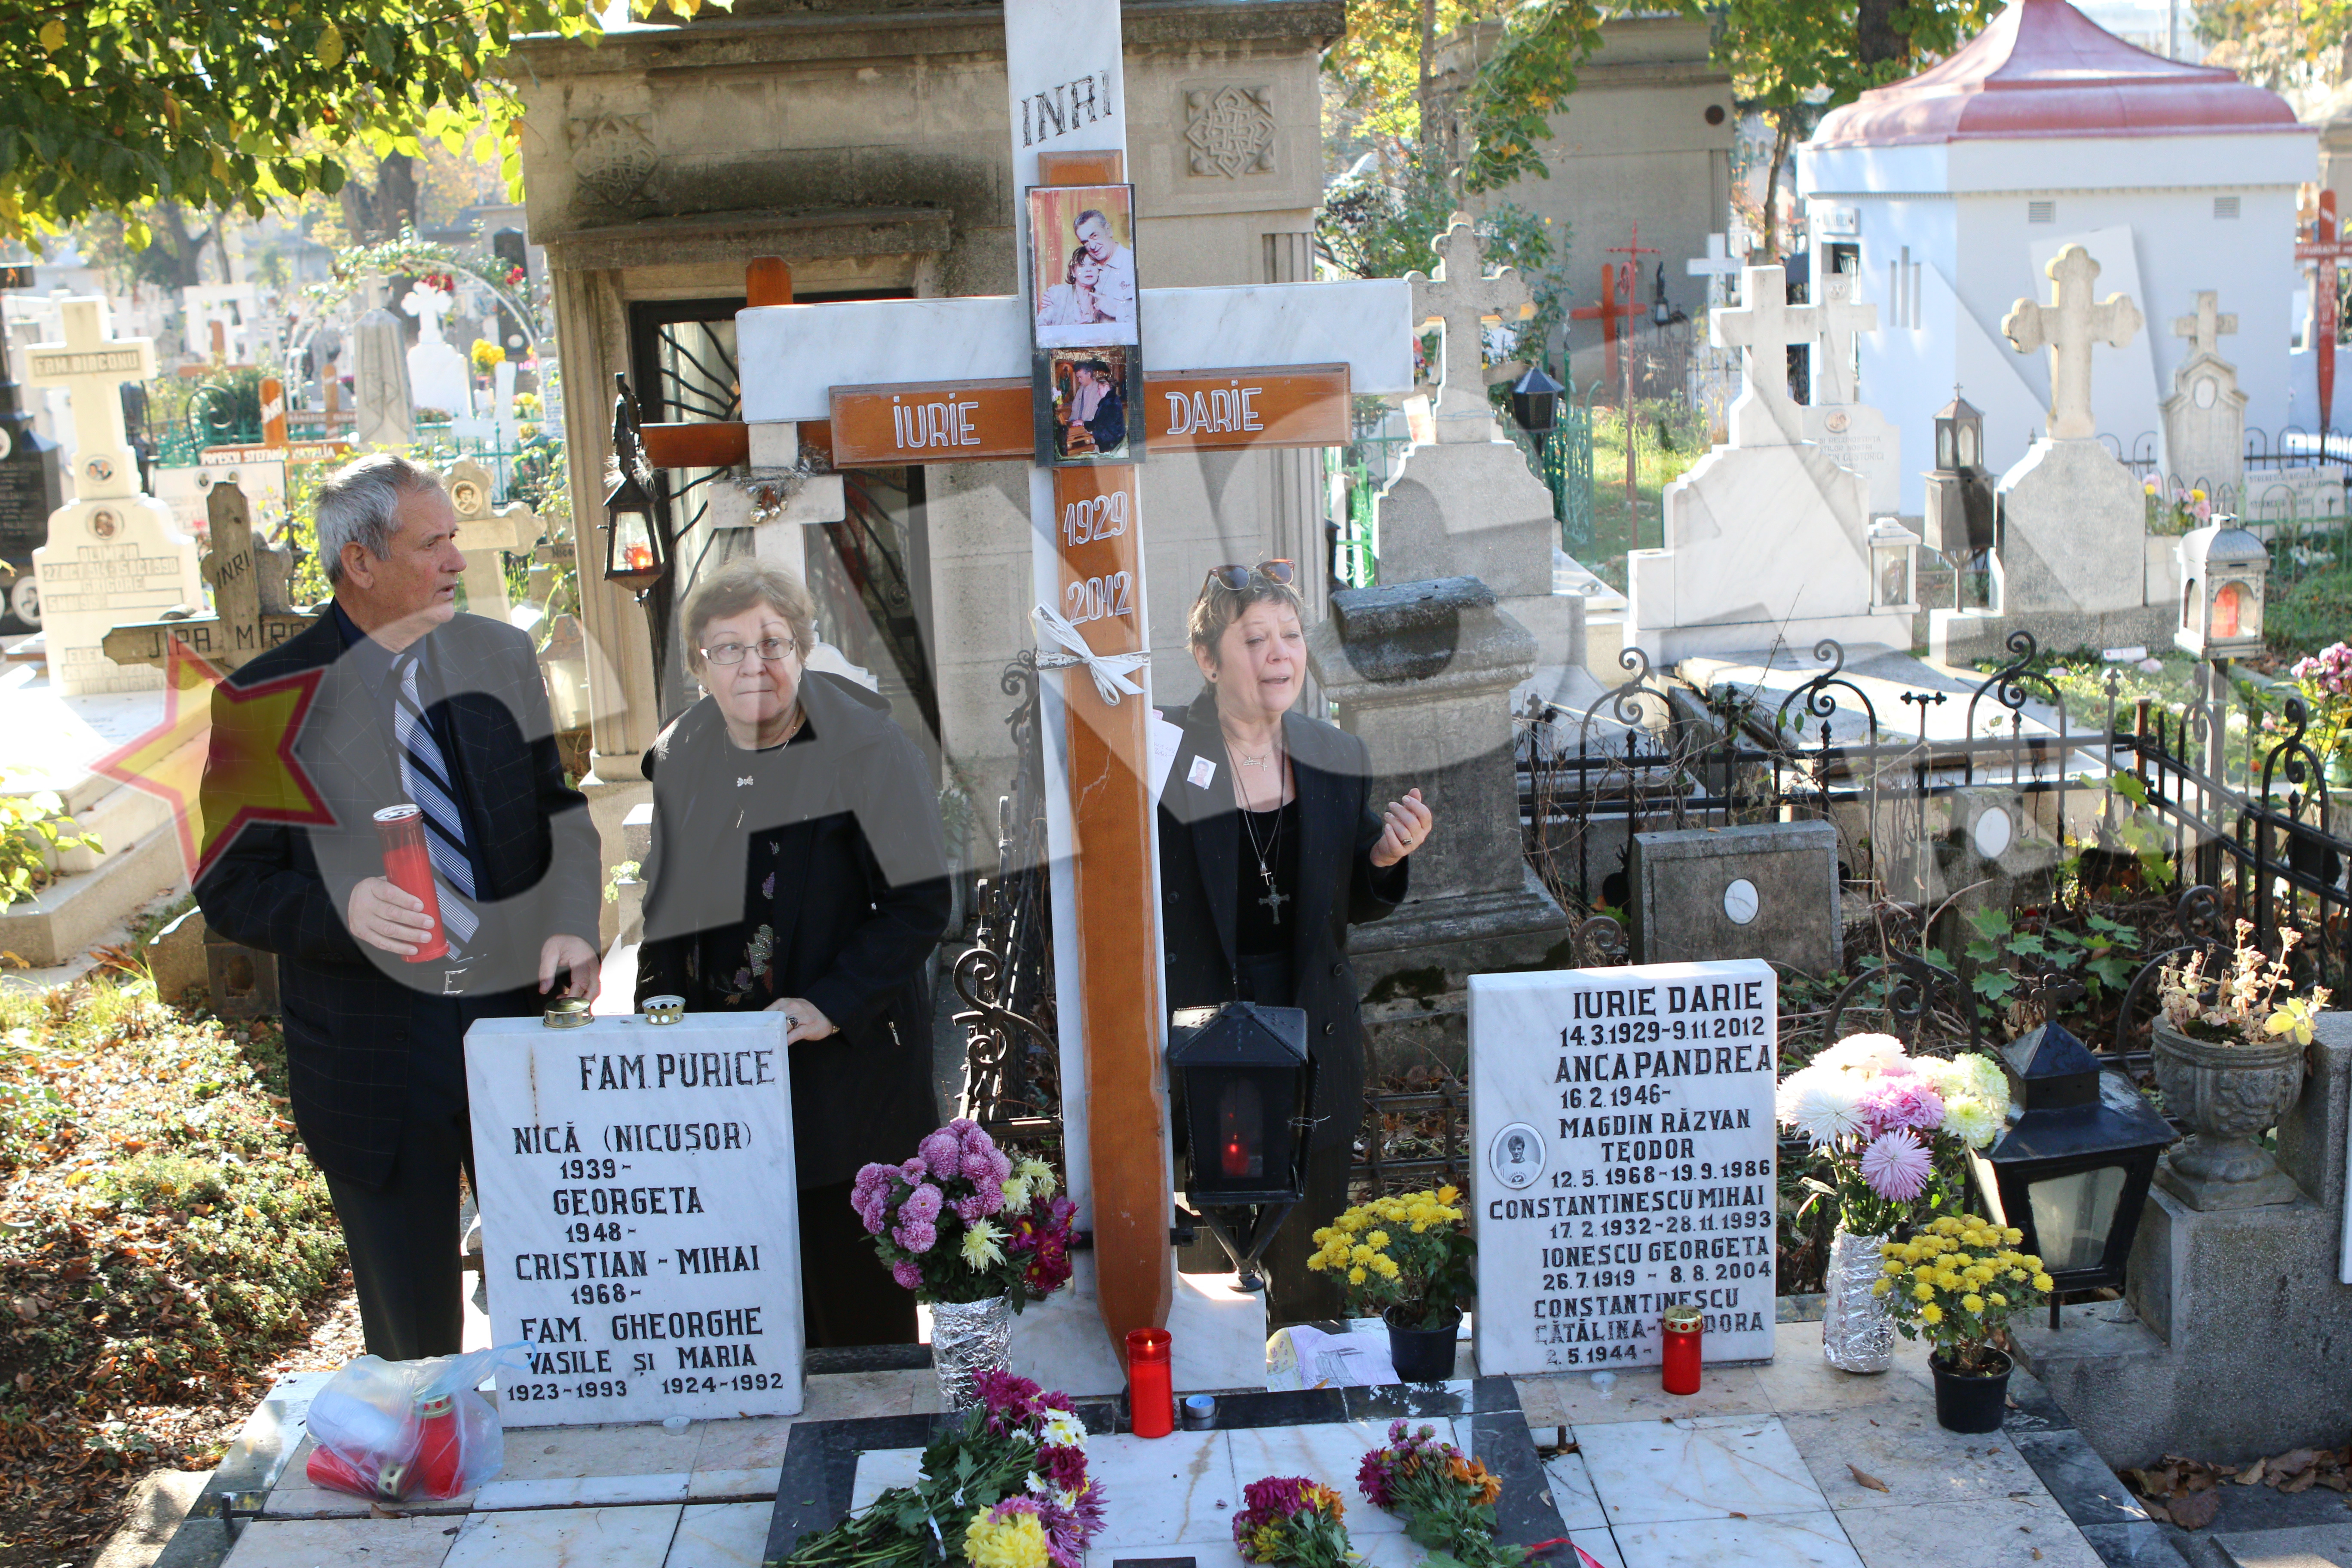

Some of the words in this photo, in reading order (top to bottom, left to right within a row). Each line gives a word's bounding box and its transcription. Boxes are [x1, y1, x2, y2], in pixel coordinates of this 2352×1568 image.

[1021, 69, 1112, 149] INRI
[1064, 491, 1130, 548] 1929
[216, 550, 251, 589] INRI
[1068, 571, 1132, 627] 2012
[149, 627, 211, 658] JIPA
[1574, 986, 1656, 1020] IURIE
[1667, 981, 1763, 1014] DARIE
[1555, 1053, 1627, 1083] ANCA
[1635, 1044, 1773, 1078] PANDREA
[513, 1121, 580, 1154] NICĂ
[1559, 1113, 1653, 1139] MAGDIN
[1661, 1107, 1751, 1133] RĂZVAN
[1602, 1138, 1694, 1163] TEODOR
[554, 1186, 704, 1216] GEORGETA
[1489, 1190, 1694, 1220] CONSTANTINESCU
[1697, 1185, 1764, 1209] MIHAI
[515, 1250, 648, 1281] CRISTIAN
[675, 1245, 761, 1275] MIHAI
[1542, 1242, 1642, 1268] IONESCU
[1649, 1235, 1769, 1262] GEORGETA
[1534, 1287, 1739, 1319] CONSTANTINESCU
[612, 1307, 763, 1340] GHEORGHE
[526, 1349, 611, 1375] VASILE
[676, 1344, 757, 1370] MARIA
